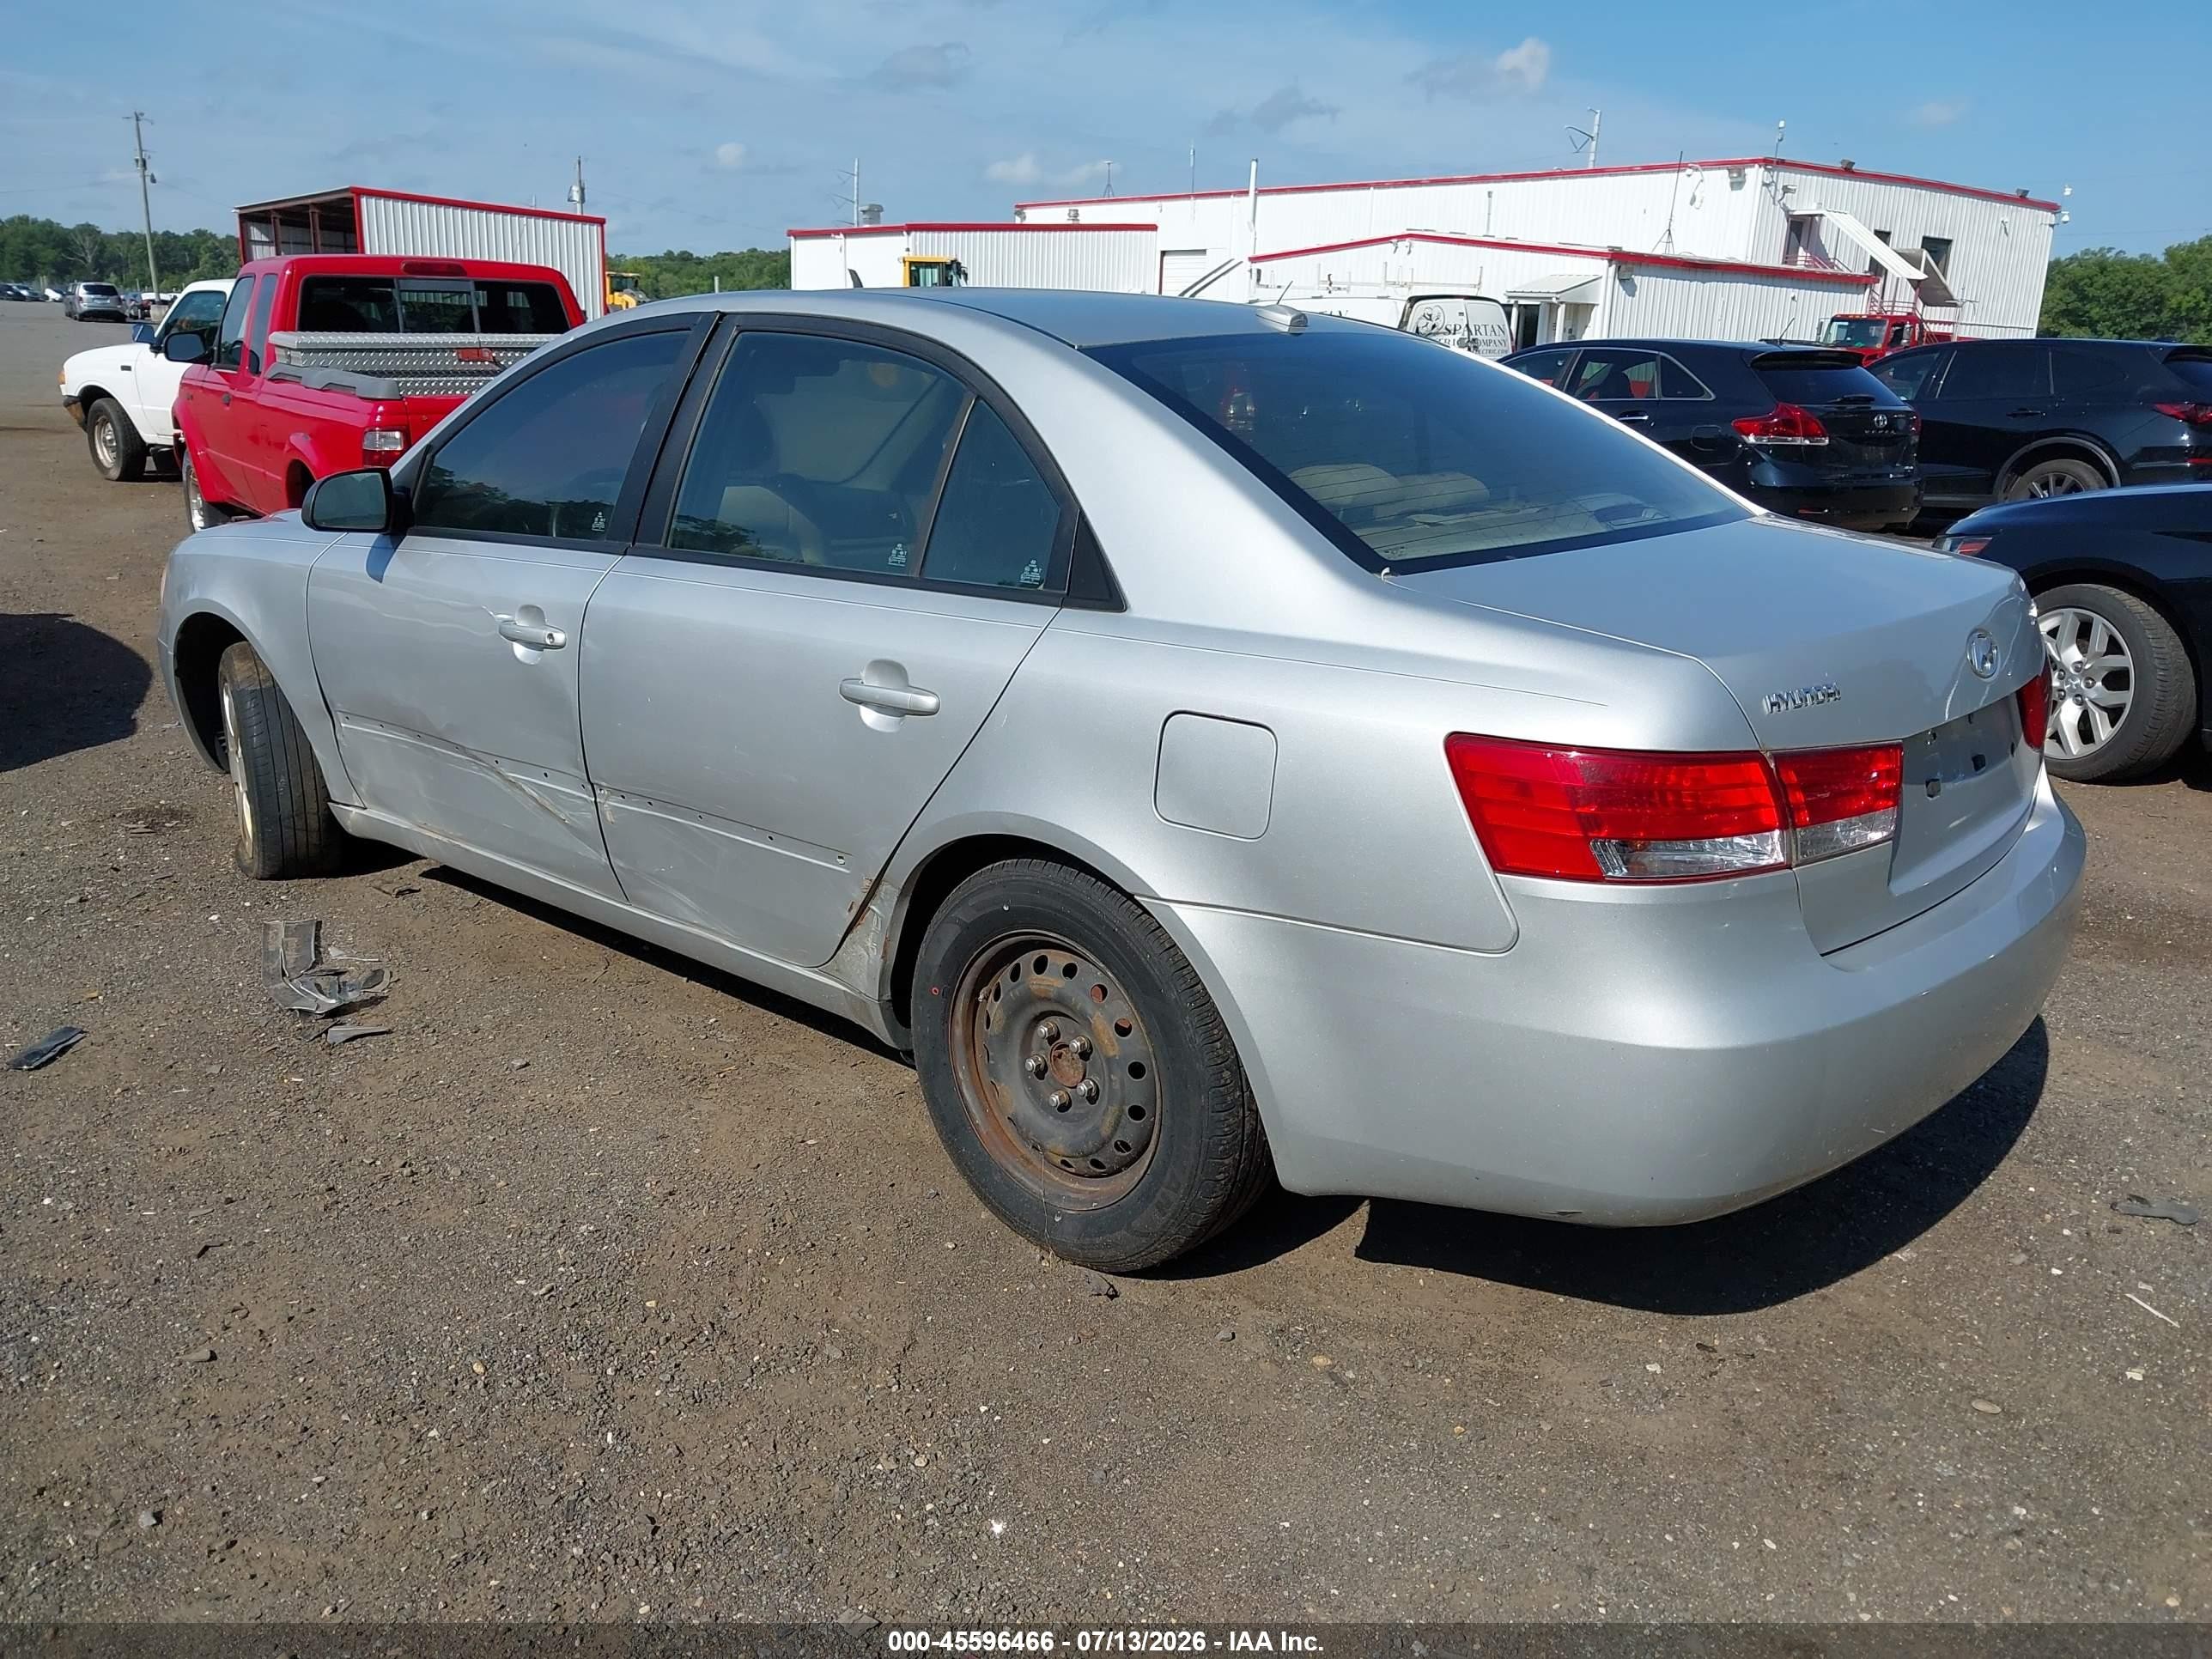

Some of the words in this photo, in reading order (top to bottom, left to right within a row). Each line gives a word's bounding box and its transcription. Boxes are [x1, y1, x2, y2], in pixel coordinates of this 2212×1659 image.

[1444, 324, 1505, 337] SPARTAN
[1470, 337, 1507, 348] OMPANY
[1762, 682, 1841, 714] HYUNDAI
